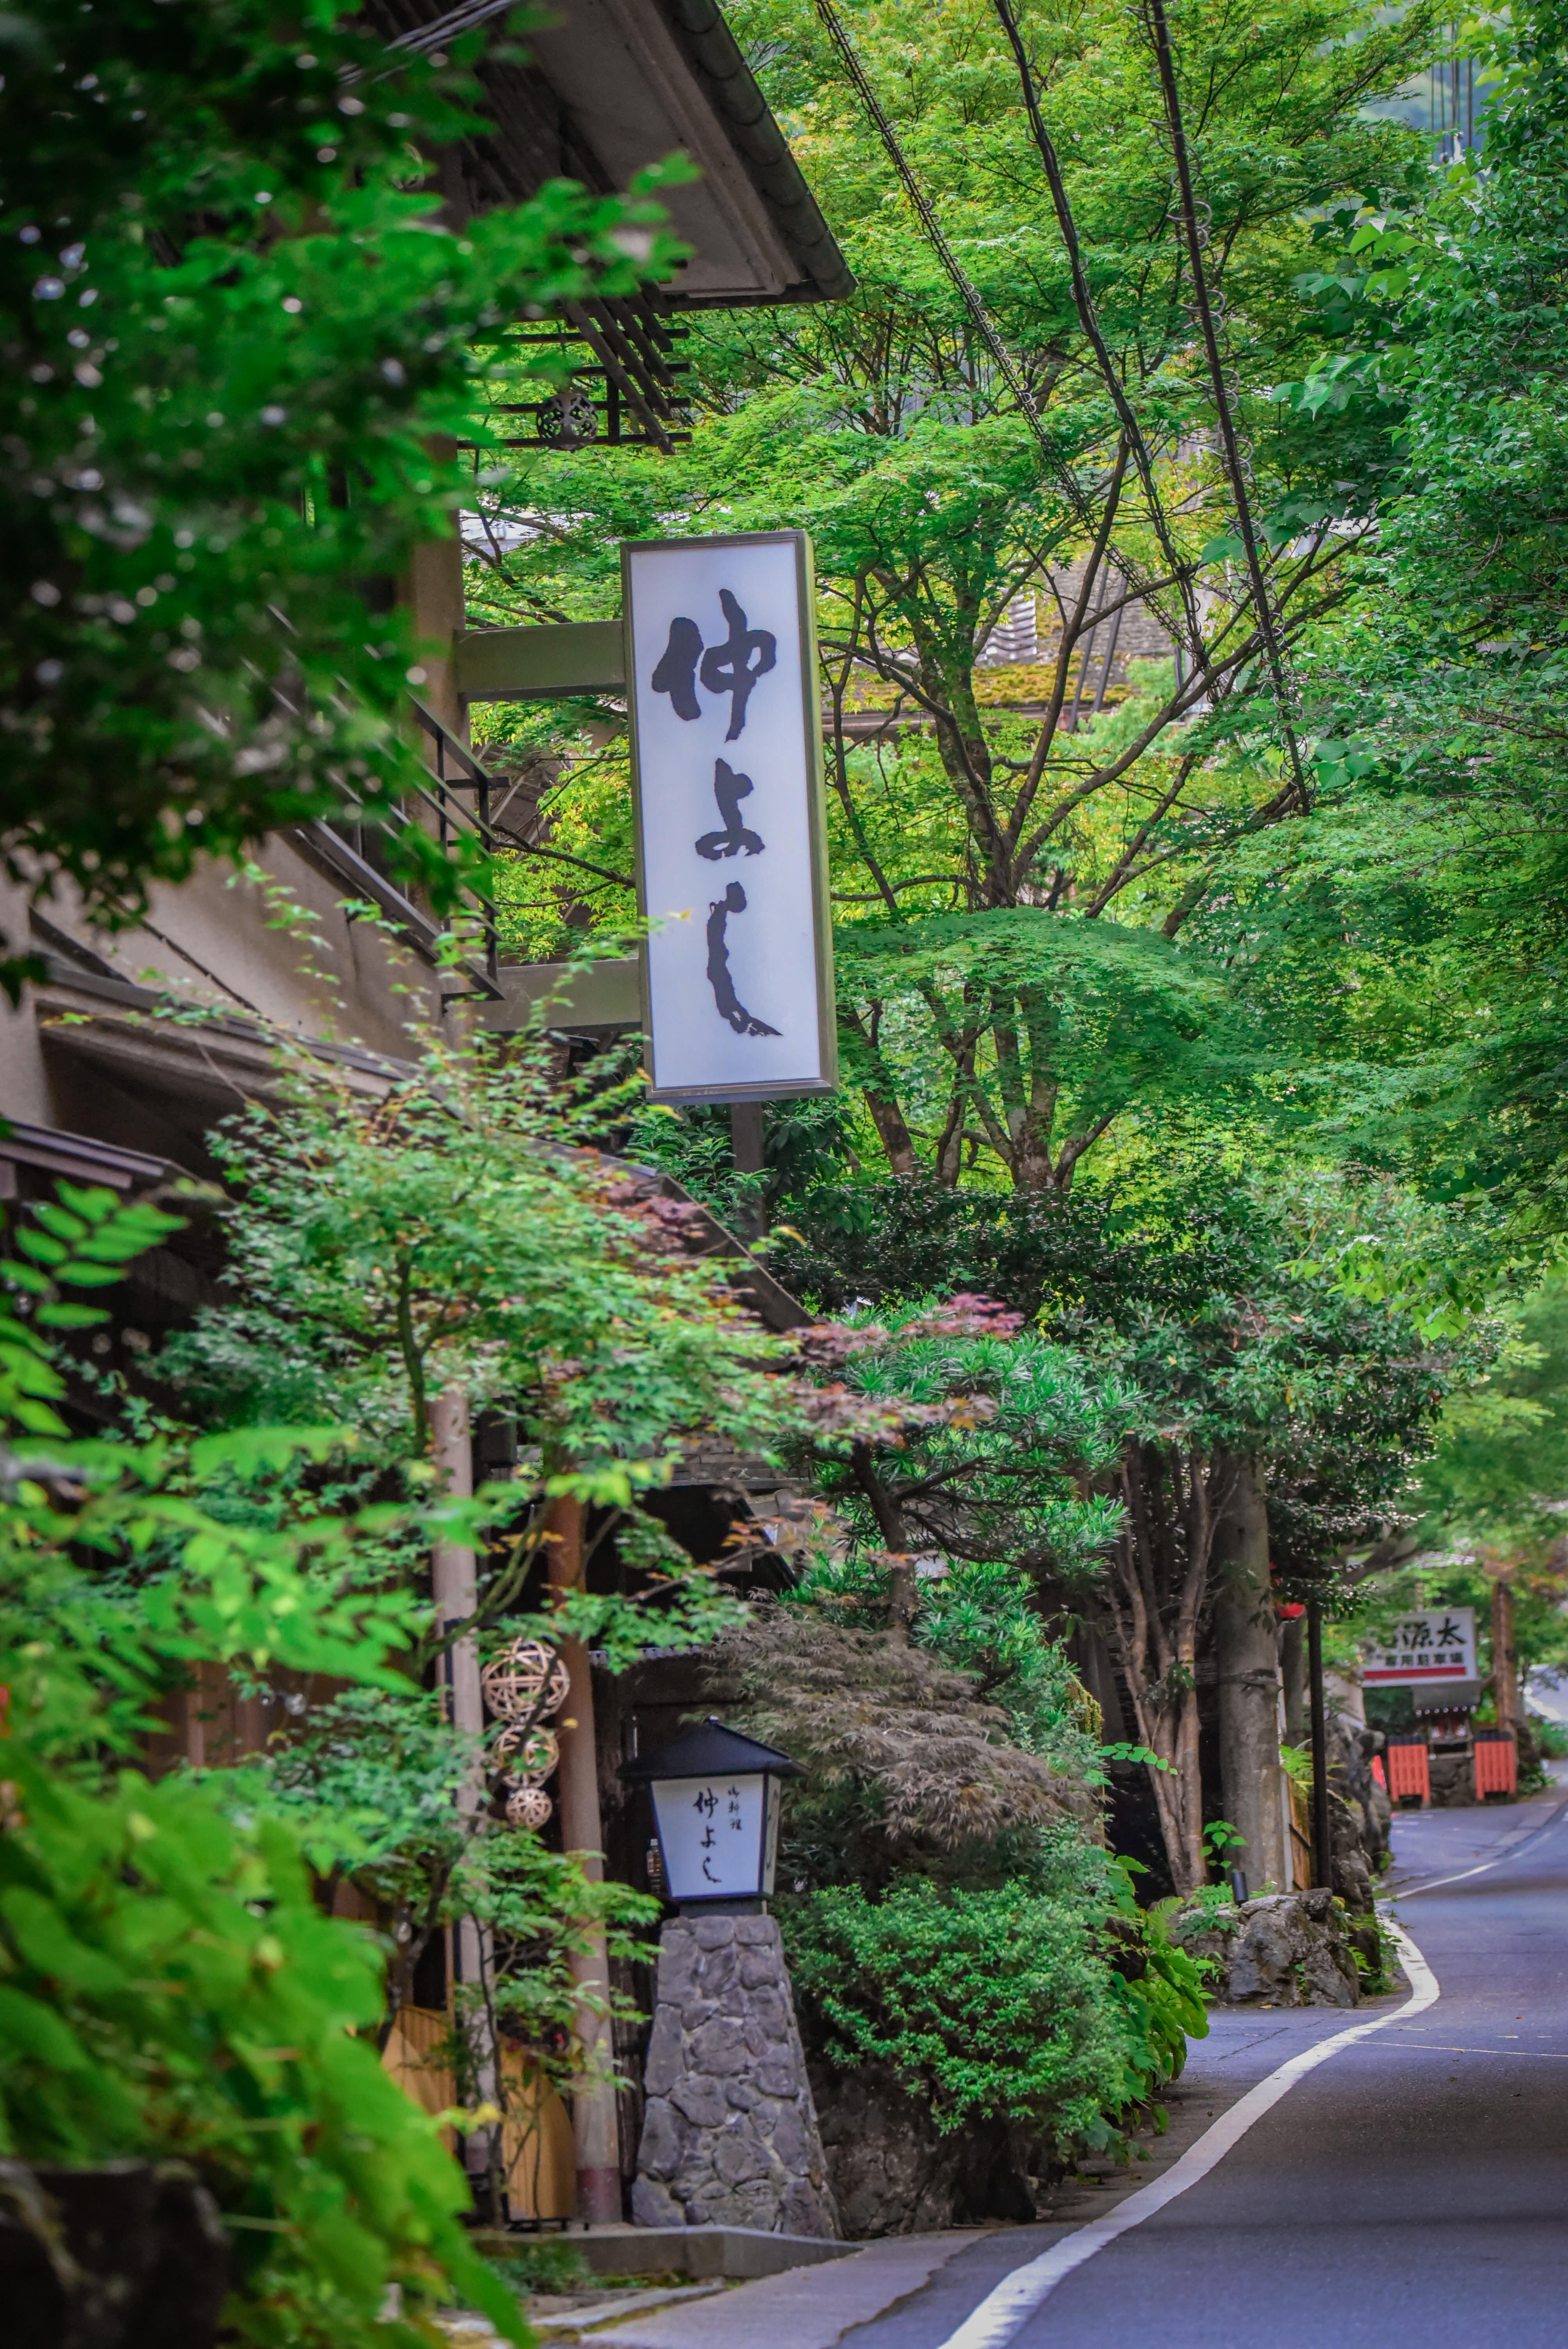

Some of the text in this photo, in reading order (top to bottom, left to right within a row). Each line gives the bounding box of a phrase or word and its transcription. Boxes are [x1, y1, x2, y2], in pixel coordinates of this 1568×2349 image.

[651, 588, 783, 1037] 仲よし
[692, 1786, 722, 1883] 仲よし
